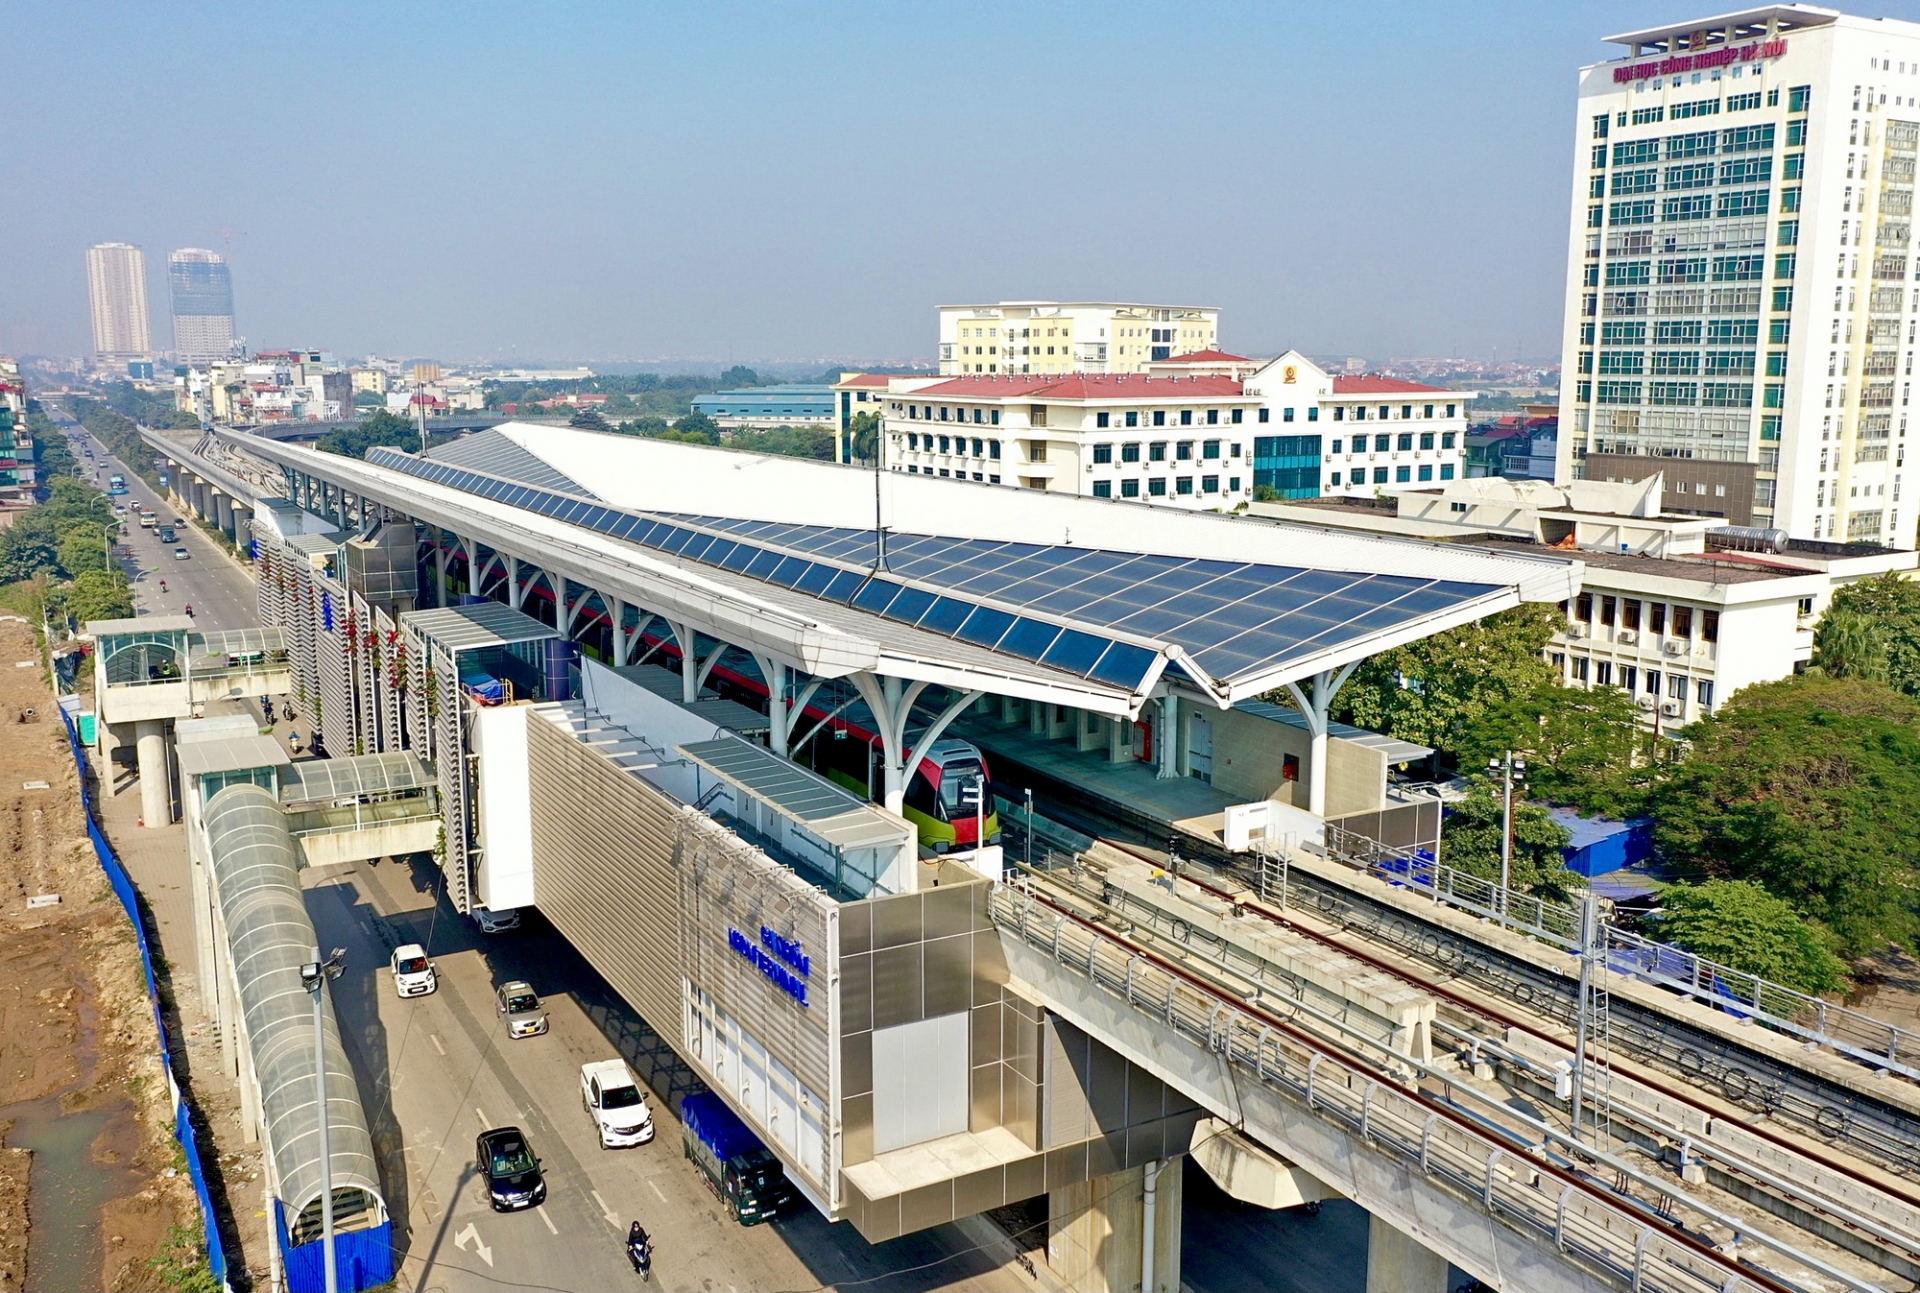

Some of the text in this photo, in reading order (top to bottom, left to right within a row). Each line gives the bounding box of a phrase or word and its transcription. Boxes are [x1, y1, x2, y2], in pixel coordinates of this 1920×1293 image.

[1613, 37, 1788, 84] ĐẠI HỌC CÔNG NGHIỆP HÀ NỘI
